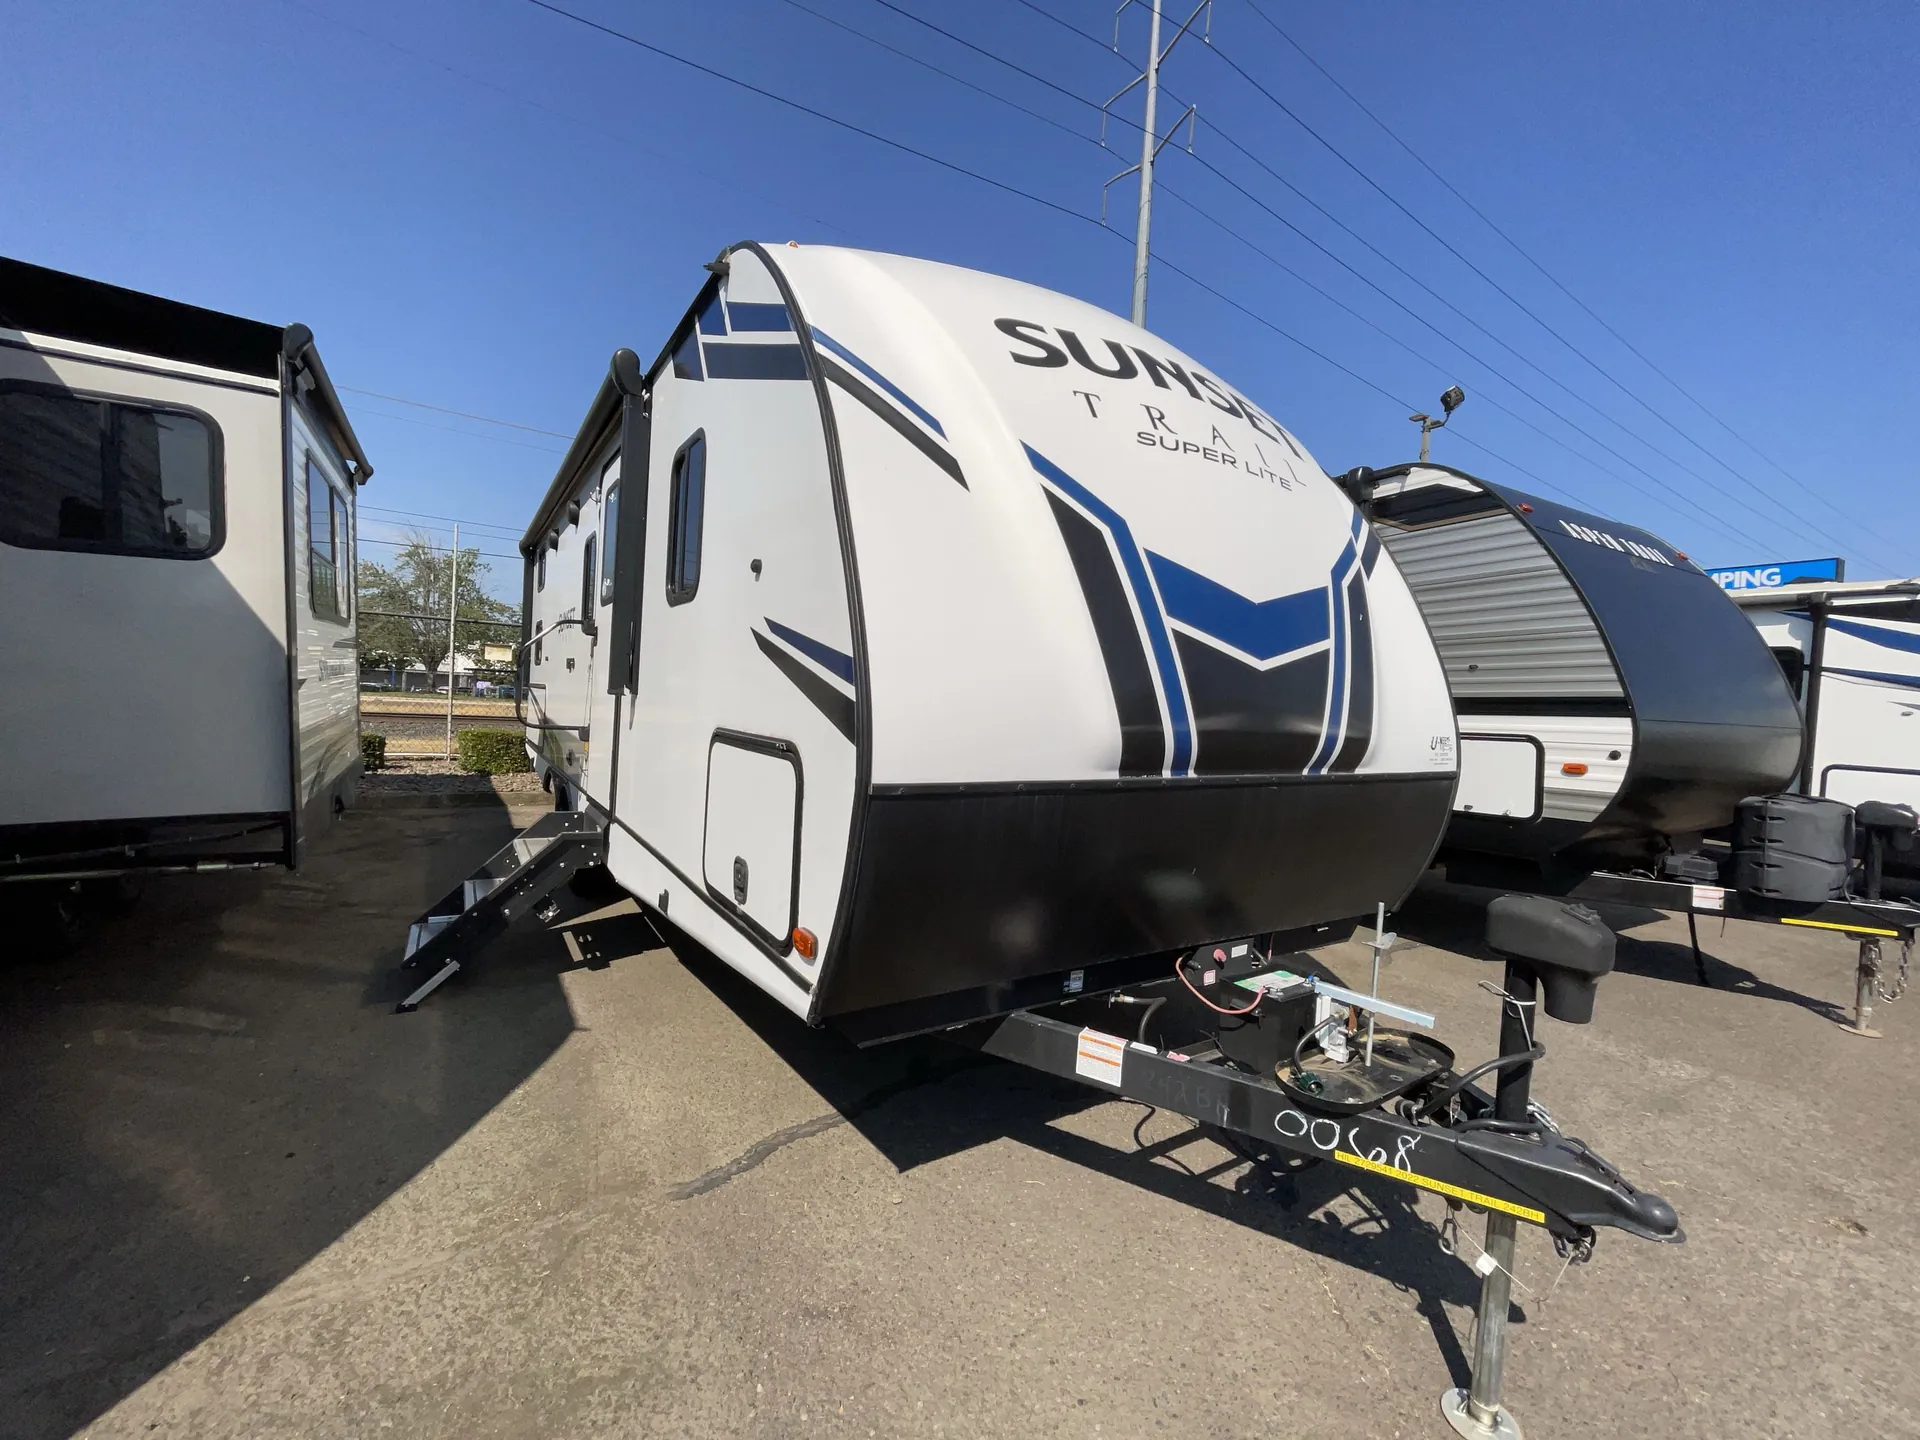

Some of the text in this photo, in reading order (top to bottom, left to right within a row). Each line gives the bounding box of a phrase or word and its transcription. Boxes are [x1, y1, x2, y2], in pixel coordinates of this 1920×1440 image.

[994, 317, 1305, 462] SUNSET
[1073, 390, 1307, 487] TRAIL
[1136, 431, 1293, 491] SUPER LITE
[1559, 519, 1674, 567] ASPEN TRAIL
[1274, 1109, 1422, 1174] 0068
[1396, 1170, 1420, 1185] 2022
[1421, 1175, 1465, 1198] SUNSET
[1469, 1192, 1501, 1208] TRAIL
[1503, 1200, 1540, 1221] 242BH
